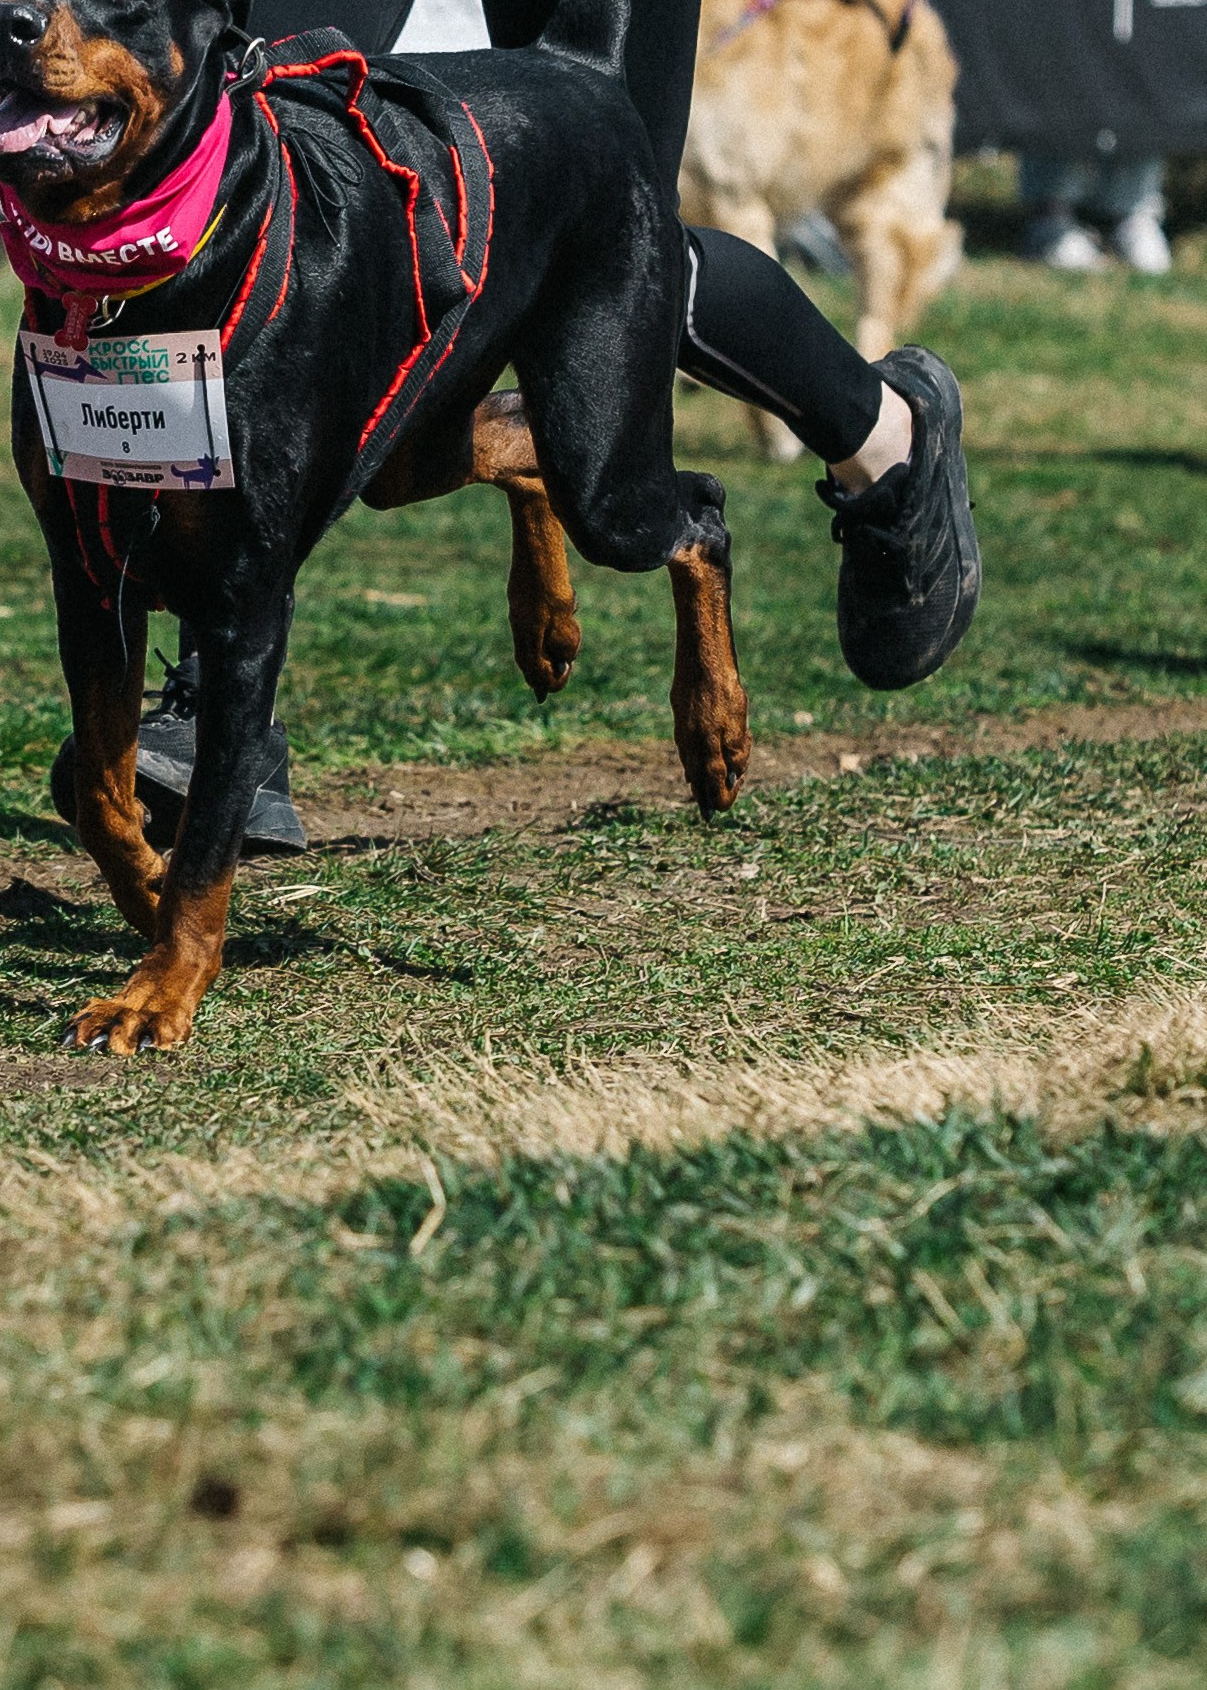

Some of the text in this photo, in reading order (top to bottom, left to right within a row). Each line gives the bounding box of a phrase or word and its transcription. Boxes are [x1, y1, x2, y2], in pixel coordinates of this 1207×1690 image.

[57, 225, 179, 265] ВМЕСТЕ
[89, 349, 169, 371] БЫСТРЫЙ
[176, 352, 187, 364] 2
[81, 403, 166, 435] Либерти
[121, 441, 131, 454] 8
